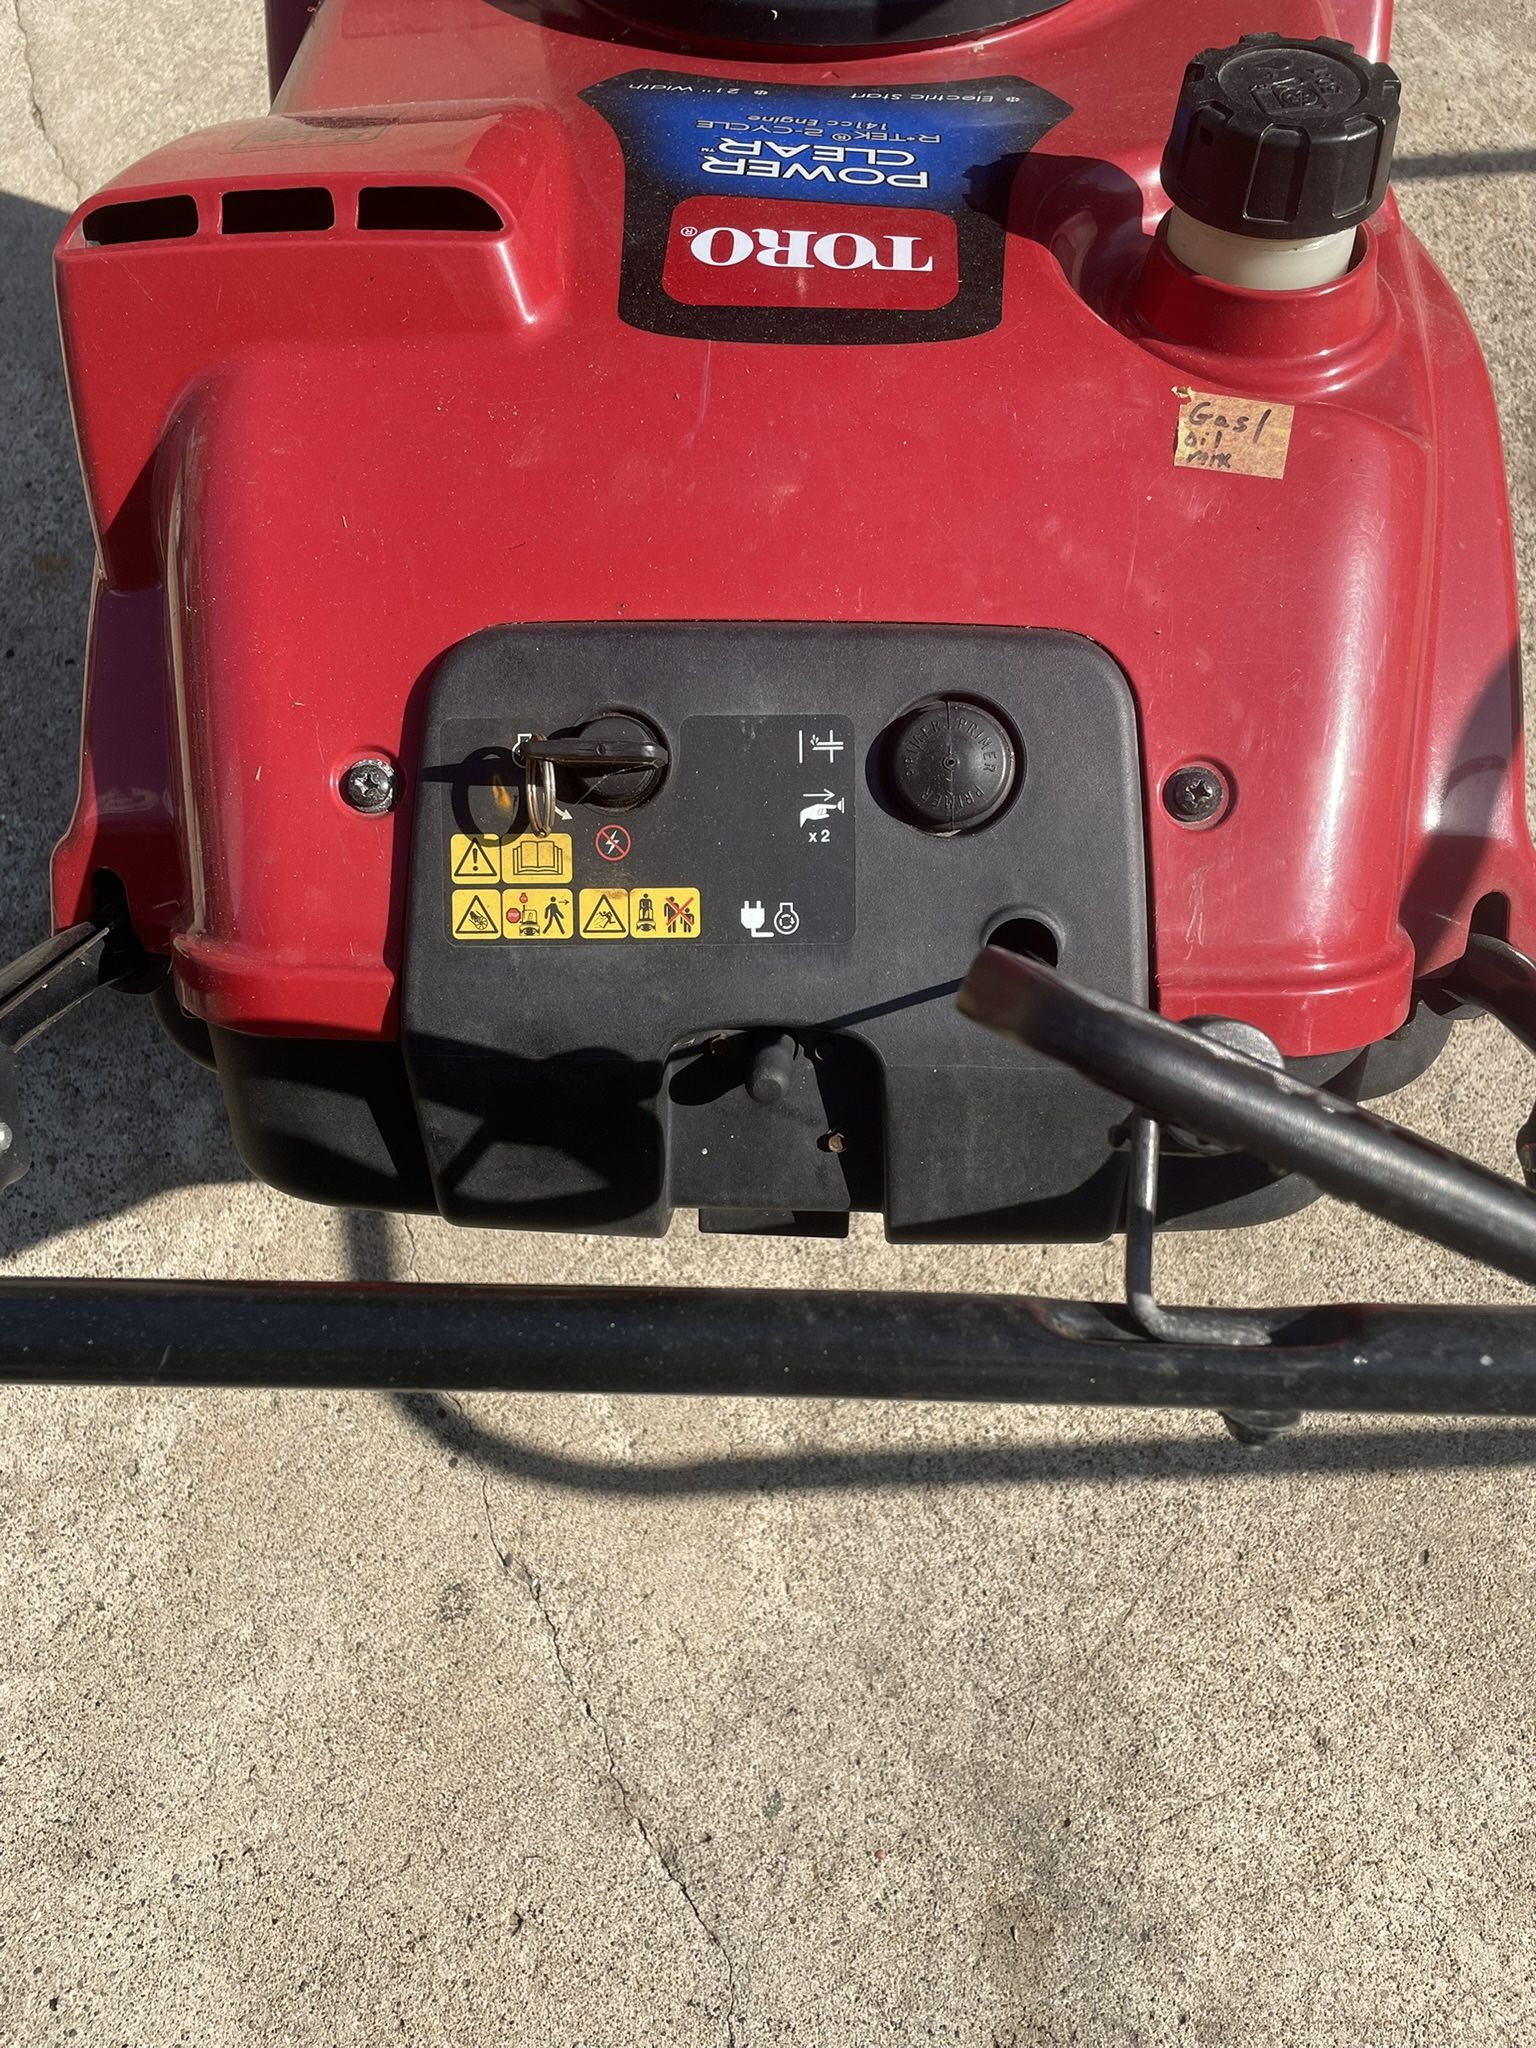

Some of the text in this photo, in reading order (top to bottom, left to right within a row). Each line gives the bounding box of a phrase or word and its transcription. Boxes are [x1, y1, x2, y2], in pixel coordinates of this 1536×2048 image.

[628, 83, 694, 92] Width
[848, 91, 994, 103] Electric Start
[695, 120, 824, 138] 2-CYCLE
[746, 113, 888, 131] 141cc Engine
[701, 155, 928, 189] POWER
[1184, 430, 1223, 449] oil
[903, 719, 942, 778] PRIMER
[956, 717, 999, 774] PRIMER
[920, 784, 986, 811] PRIMER
